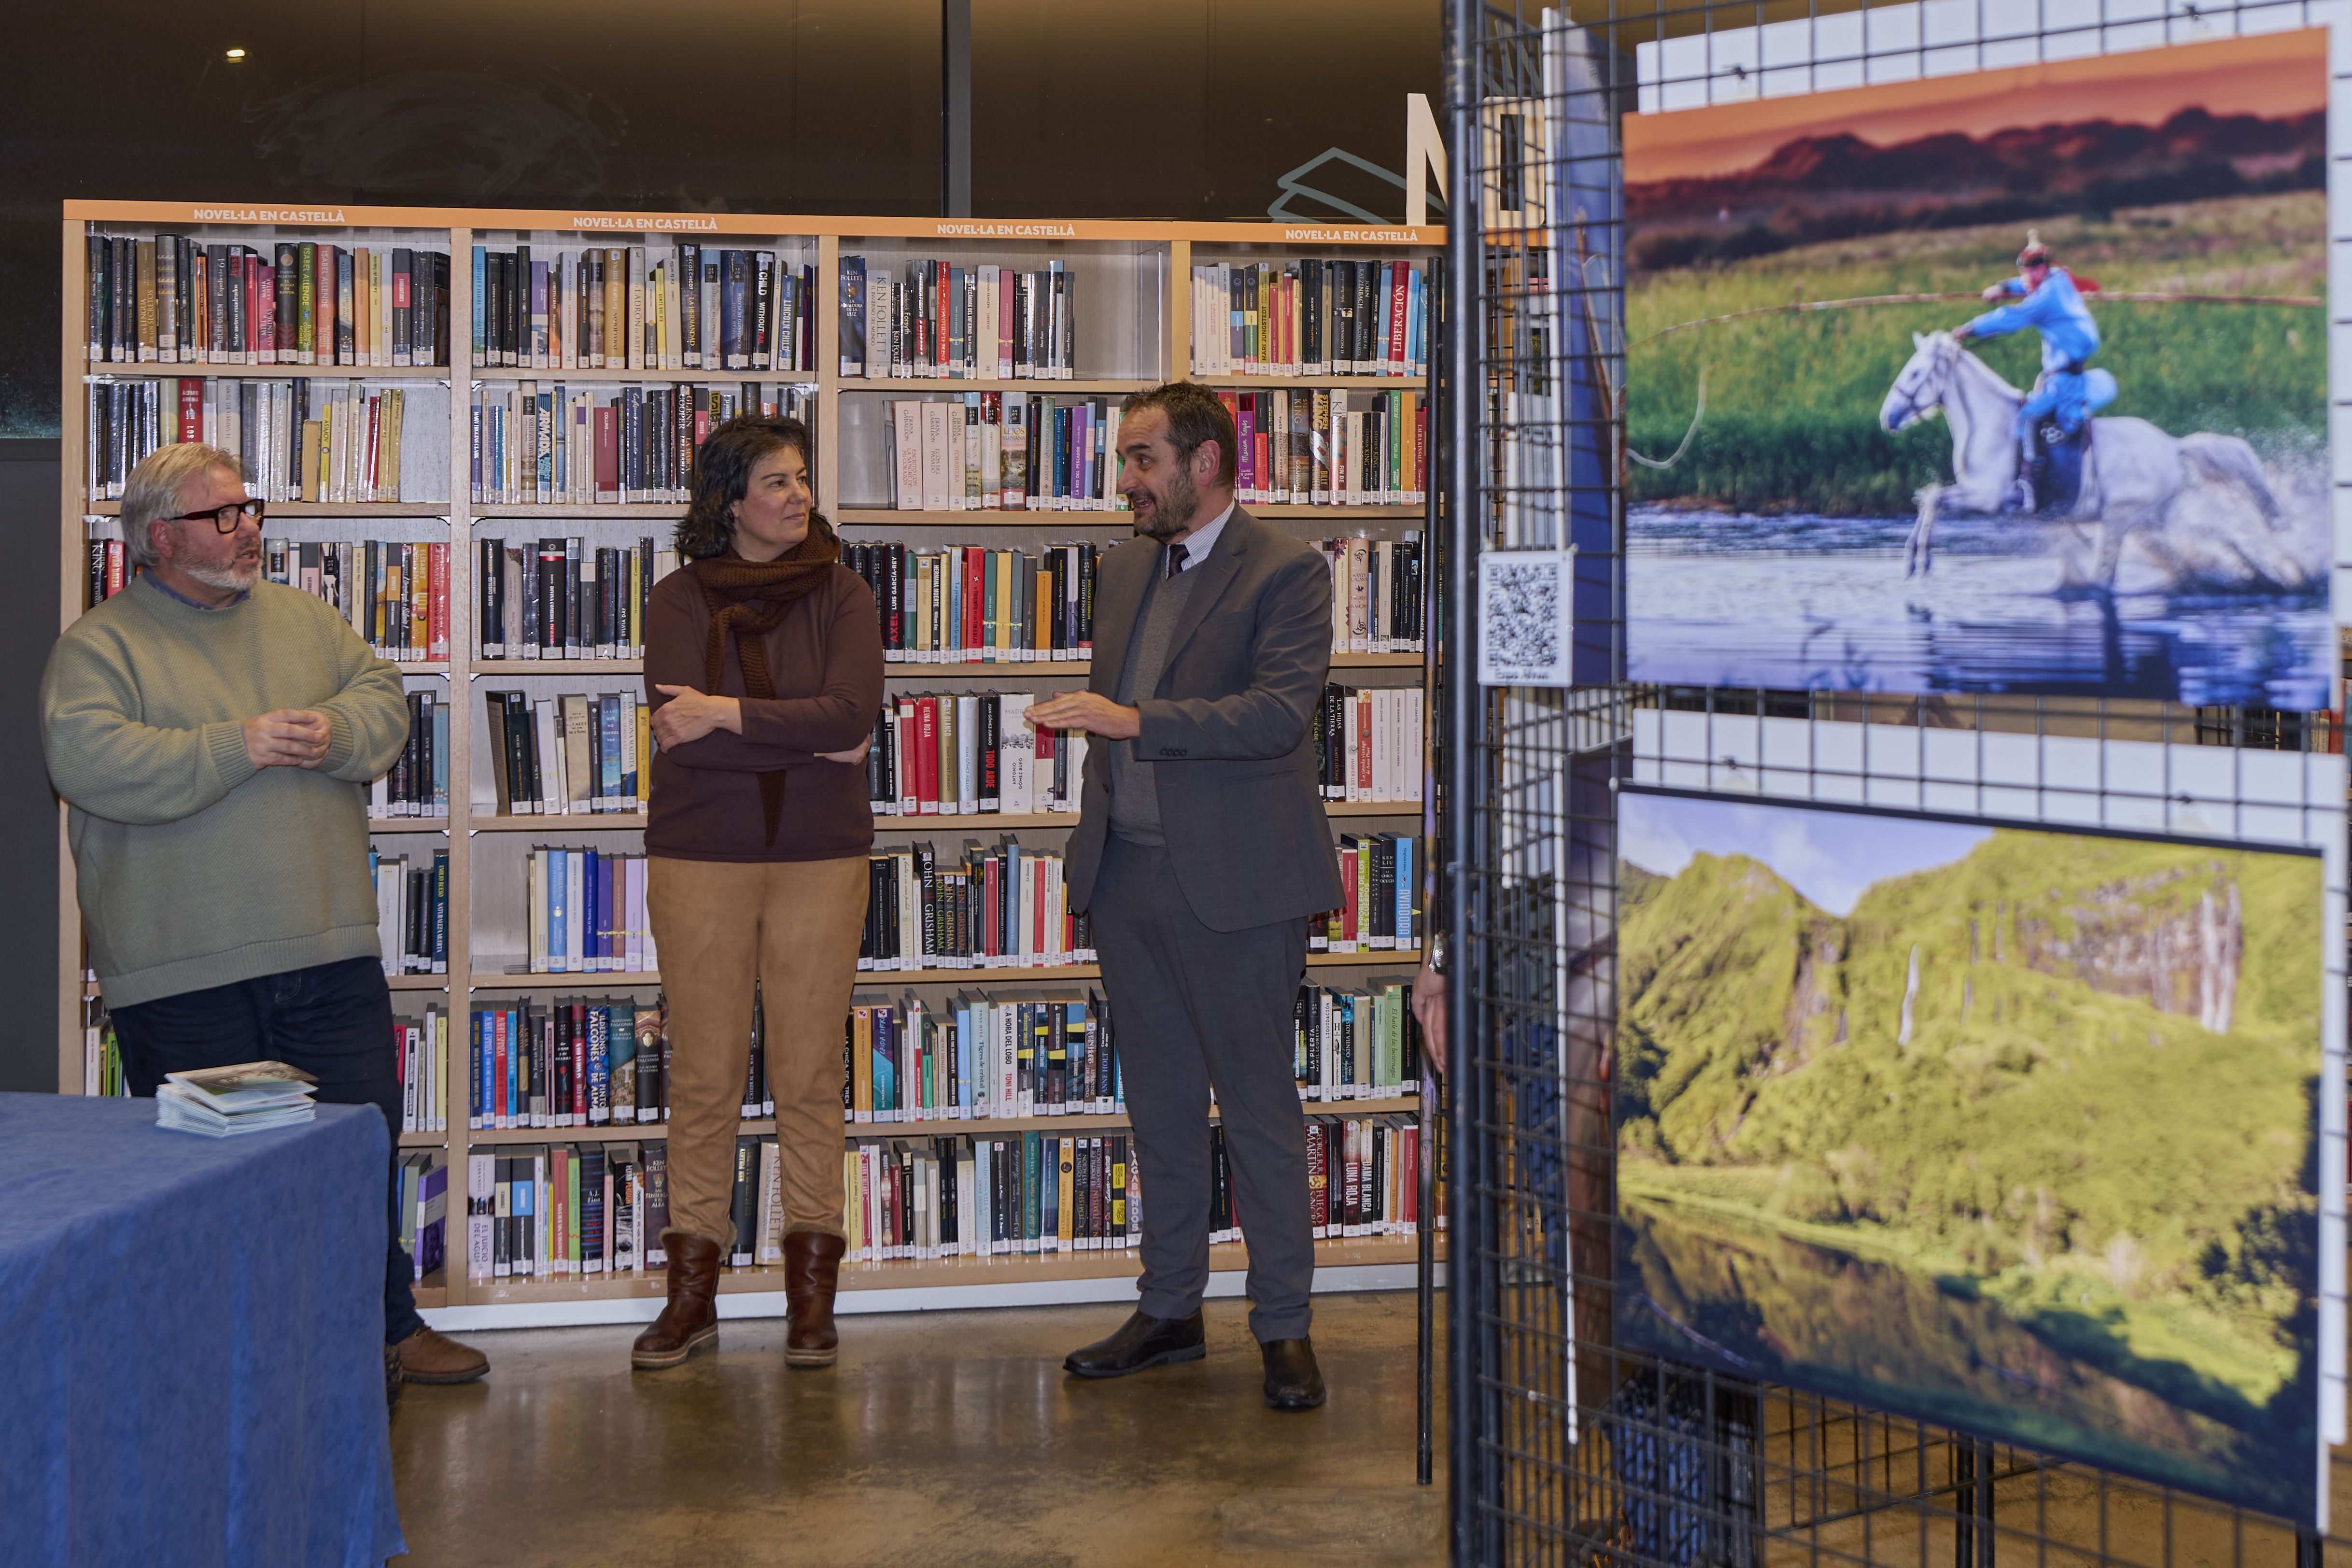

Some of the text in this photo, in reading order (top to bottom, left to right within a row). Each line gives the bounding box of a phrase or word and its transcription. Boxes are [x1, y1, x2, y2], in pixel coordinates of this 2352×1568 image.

[194, 209, 345, 222] NOVEL·LA EN CASTELLÀ
[574, 217, 717, 230] NOVEL·LA EN CASTELLÀ
[937, 224, 1075, 236] NOVEL·LA EN CASTELLÀ
[1286, 229, 1418, 241] NOVEL·LA EN CASTELLÀ
[218, 258, 225, 268] 64
[758, 272, 767, 296] CHILD
[781, 299, 791, 351] LINCOLN CHILD
[877, 277, 887, 355] KEN FOLLETT
[903, 312, 911, 334] Forsyth
[1393, 284, 1404, 352] LIBERACIÓN
[1312, 394, 1323, 431] KING
[1240, 420, 1251, 436] Keyes
[890, 613, 899, 642] AXEL
[986, 749, 995, 788] TODO ARDE
[1359, 876, 1364, 885] DE
[1399, 889, 1410, 934] AVIADORA
[925, 904, 933, 953] GRISHAM
[590, 1011, 599, 1061] FALCONES
[1310, 1060, 1314, 1069] LA
[1346, 1162, 1358, 1206] LUNA ROJA
[1362, 1161, 1371, 1212] DAMA BLANCA
[482, 1224, 488, 1234] EL
